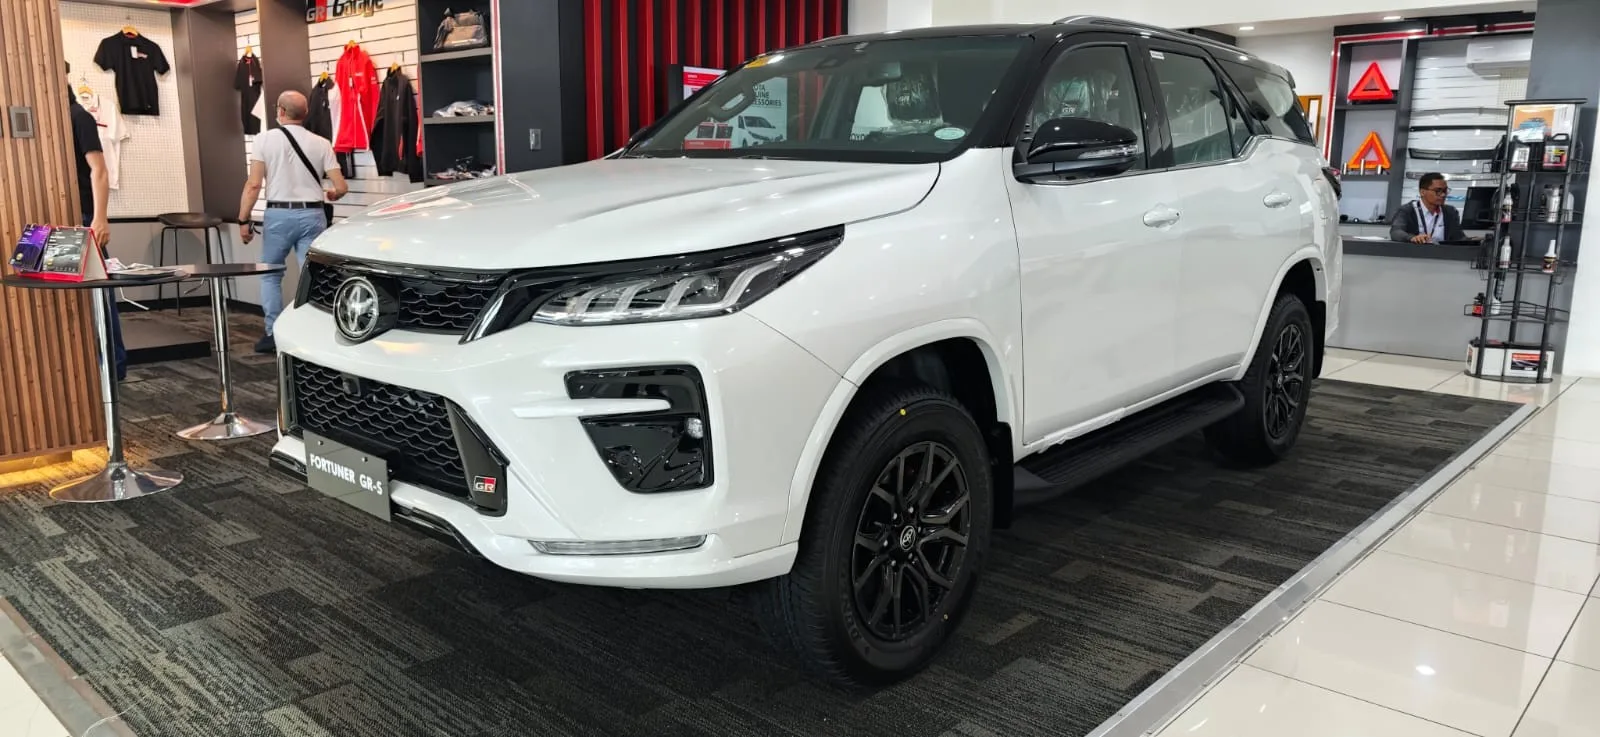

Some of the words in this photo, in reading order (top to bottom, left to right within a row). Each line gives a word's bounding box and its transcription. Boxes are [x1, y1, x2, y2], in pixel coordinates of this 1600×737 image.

[306, 6, 327, 22] GR
[310, 453, 356, 484] FORTUNER
[360, 473, 383, 495] GR-S
[475, 481, 495, 492] GR
